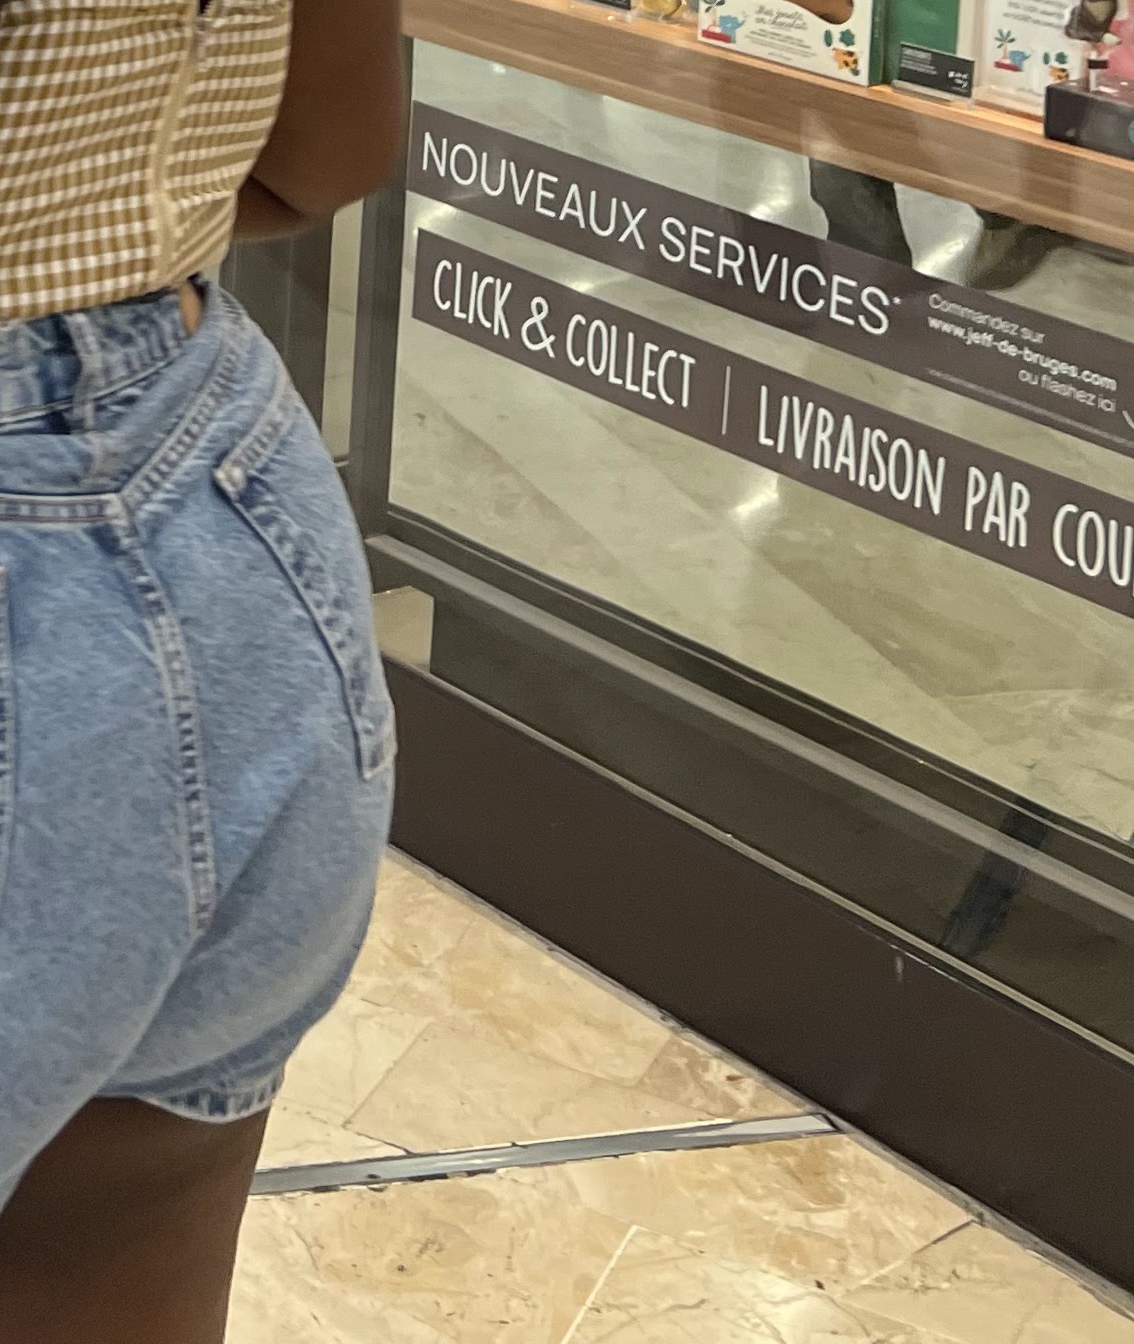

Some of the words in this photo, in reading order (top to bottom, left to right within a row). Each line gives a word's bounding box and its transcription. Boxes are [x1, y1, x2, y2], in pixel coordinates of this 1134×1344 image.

[422, 132, 647, 250] NOUVEAUX
[433, 259, 513, 339] CLICK
[521, 296, 556, 359] &
[566, 314, 696, 408] COLLECT
[928, 293, 1019, 336] Commandez
[1020, 326, 1046, 344] sur
[1018, 369, 1039, 386] ou
[758, 385, 946, 516] LIVRAISON
[964, 466, 1031, 548] PAR
[1052, 503, 1134, 598] COU
